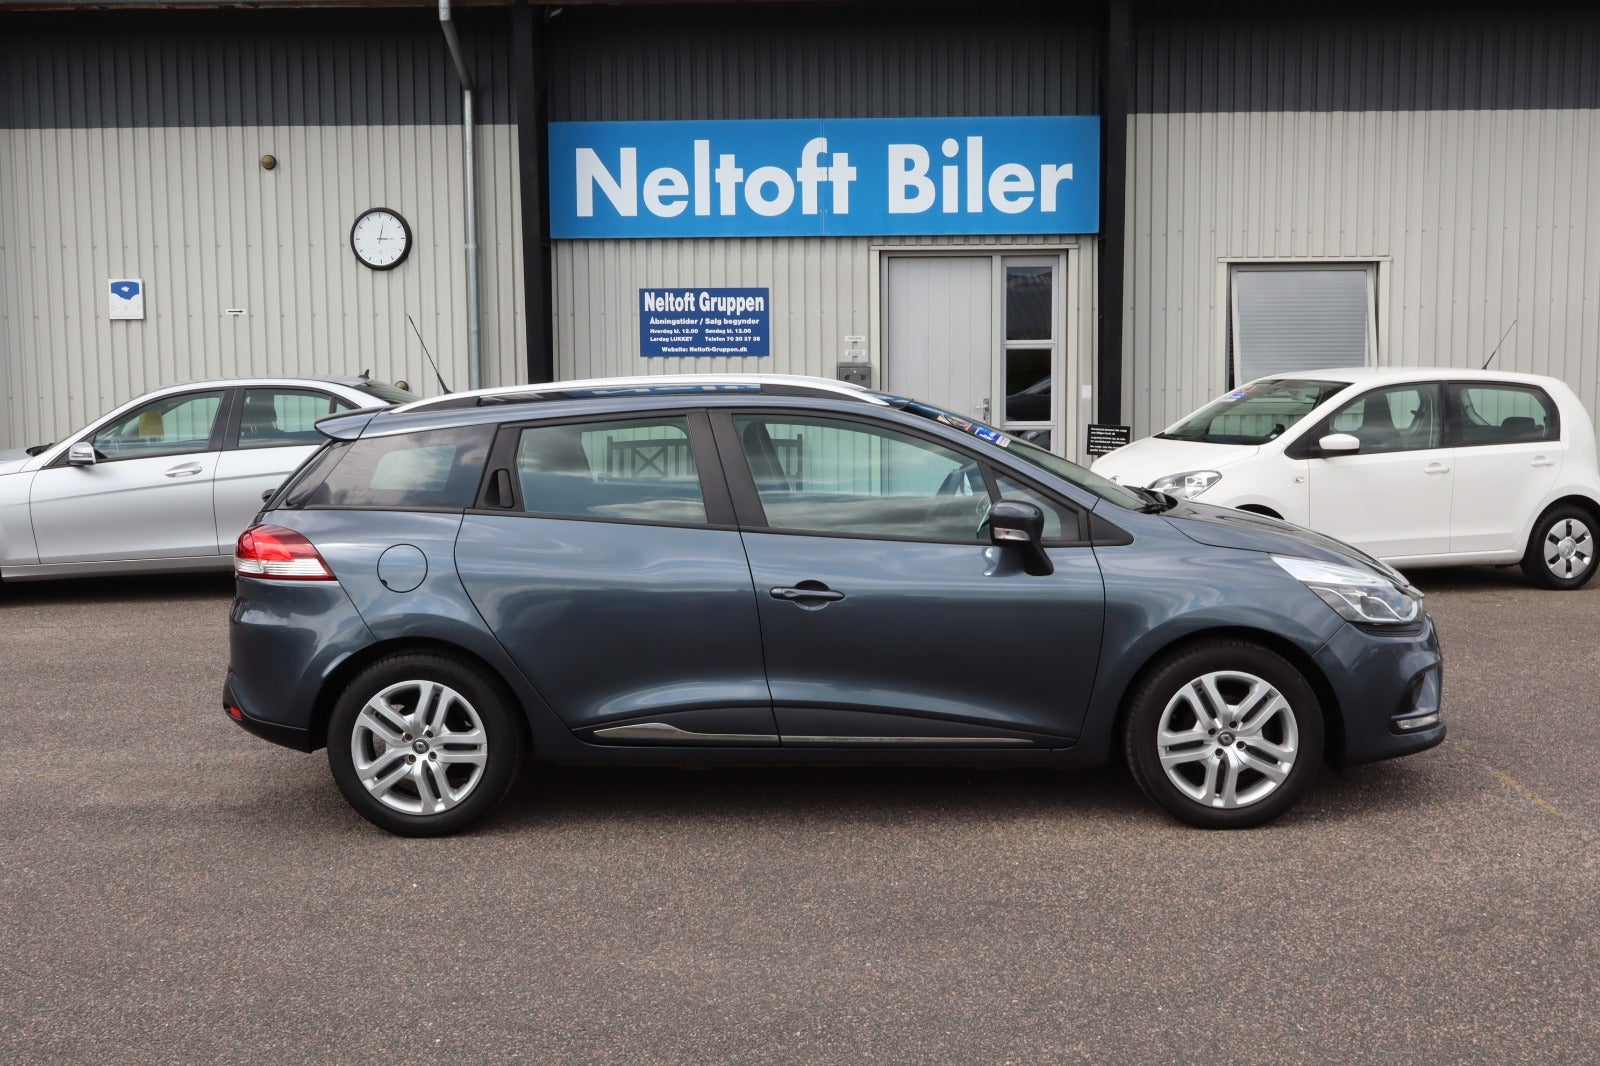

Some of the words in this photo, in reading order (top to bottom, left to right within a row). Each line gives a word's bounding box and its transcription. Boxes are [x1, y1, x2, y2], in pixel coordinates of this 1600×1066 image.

[575, 137, 857, 218] Neltoft
[888, 135, 1073, 214] Biler
[644, 291, 696, 312] Neltoft
[699, 291, 765, 316] Gruppen
[649, 316, 699, 326] Åbningstider
[704, 318, 722, 326] Salg
[723, 318, 760, 326] begynder
